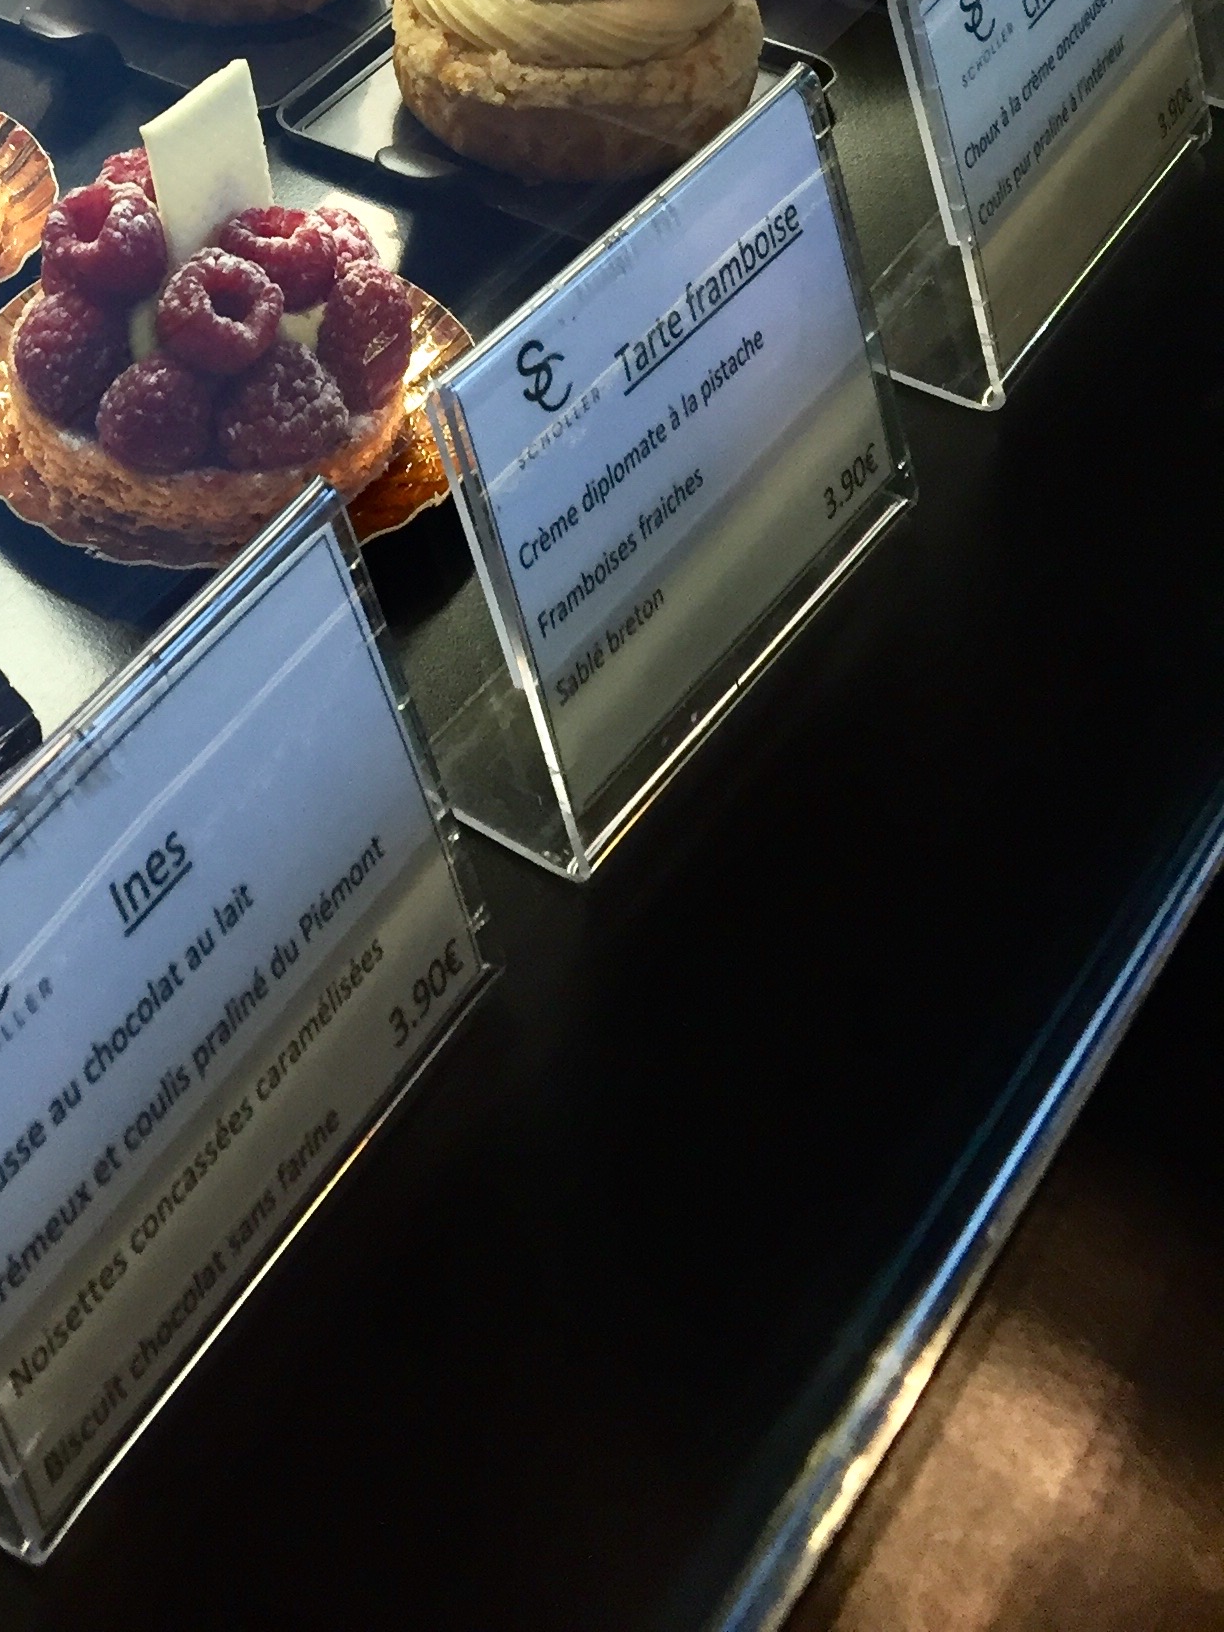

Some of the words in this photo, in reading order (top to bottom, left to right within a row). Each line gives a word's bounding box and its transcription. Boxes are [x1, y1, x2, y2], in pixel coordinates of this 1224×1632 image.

[961, 22, 1013, 88] SCHOLLER
[964, 119, 1000, 169] Choux
[999, 105, 1009, 127] à
[1008, 95, 1021, 116] la
[977, 176, 1012, 225] Coulis
[1012, 150, 1031, 189] pur
[1069, 92, 1077, 112] à
[613, 310, 687, 381] Tarte
[685, 203, 803, 321] framboise
[518, 505, 578, 569] Crème
[581, 423, 667, 512] diplomate
[668, 405, 680, 430] à
[681, 393, 698, 417] la
[700, 330, 763, 406] pistache
[823, 442, 878, 519] 3.90€
[537, 532, 637, 638] Framboises
[555, 641, 604, 706] Sablé
[605, 588, 664, 654] breton
[108, 830, 185, 923] Ines
[48, 1080, 81, 1125] au
[83, 962, 183, 1084] chocolat
[185, 928, 215, 970] au
[213, 884, 253, 934] lait
[93, 1145, 121, 1186] et
[122, 1064, 190, 1152] coulis
[191, 966, 268, 1079] praliné
[270, 938, 299, 979] du
[298, 836, 384, 943] Piémont
[388, 937, 463, 1047] 3.90€
[5, 1250, 127, 1399] Noisettes
[129, 1096, 253, 1254] concassées
[255, 937, 383, 1101] caramélisées
[42, 1374, 127, 1486] Biscuit
[129, 1251, 226, 1380] chocolat
[227, 1188, 276, 1256] sans
[276, 1109, 339, 1192] farine
